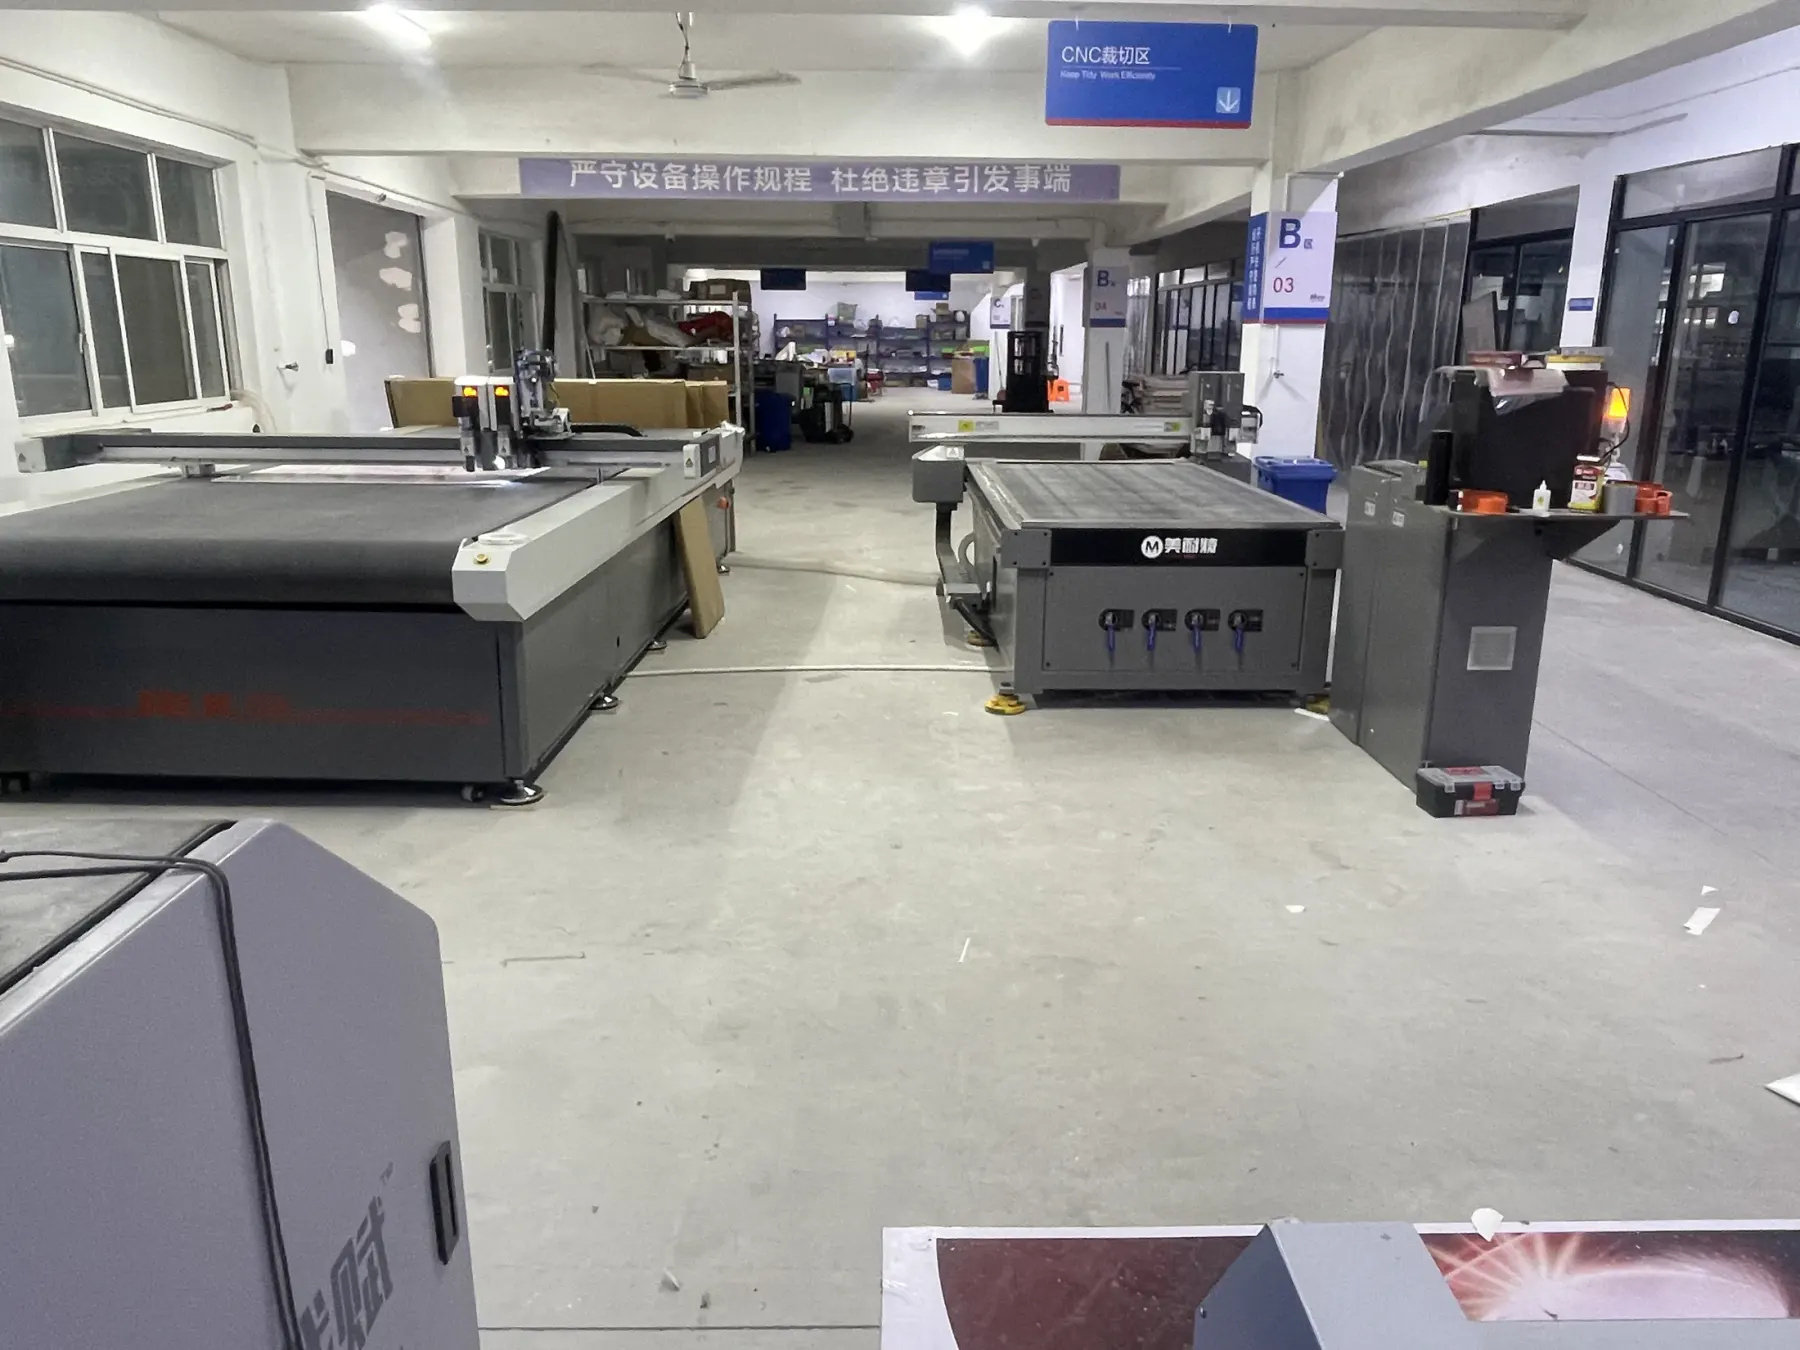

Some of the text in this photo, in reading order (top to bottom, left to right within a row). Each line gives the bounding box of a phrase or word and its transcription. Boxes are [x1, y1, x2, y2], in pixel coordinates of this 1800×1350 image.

[1061, 46, 1150, 64] CNC裁切区
[568, 159, 1072, 194] 严守设备操作规程 杜绝违章引发事端
[1273, 277, 1295, 293] 03
